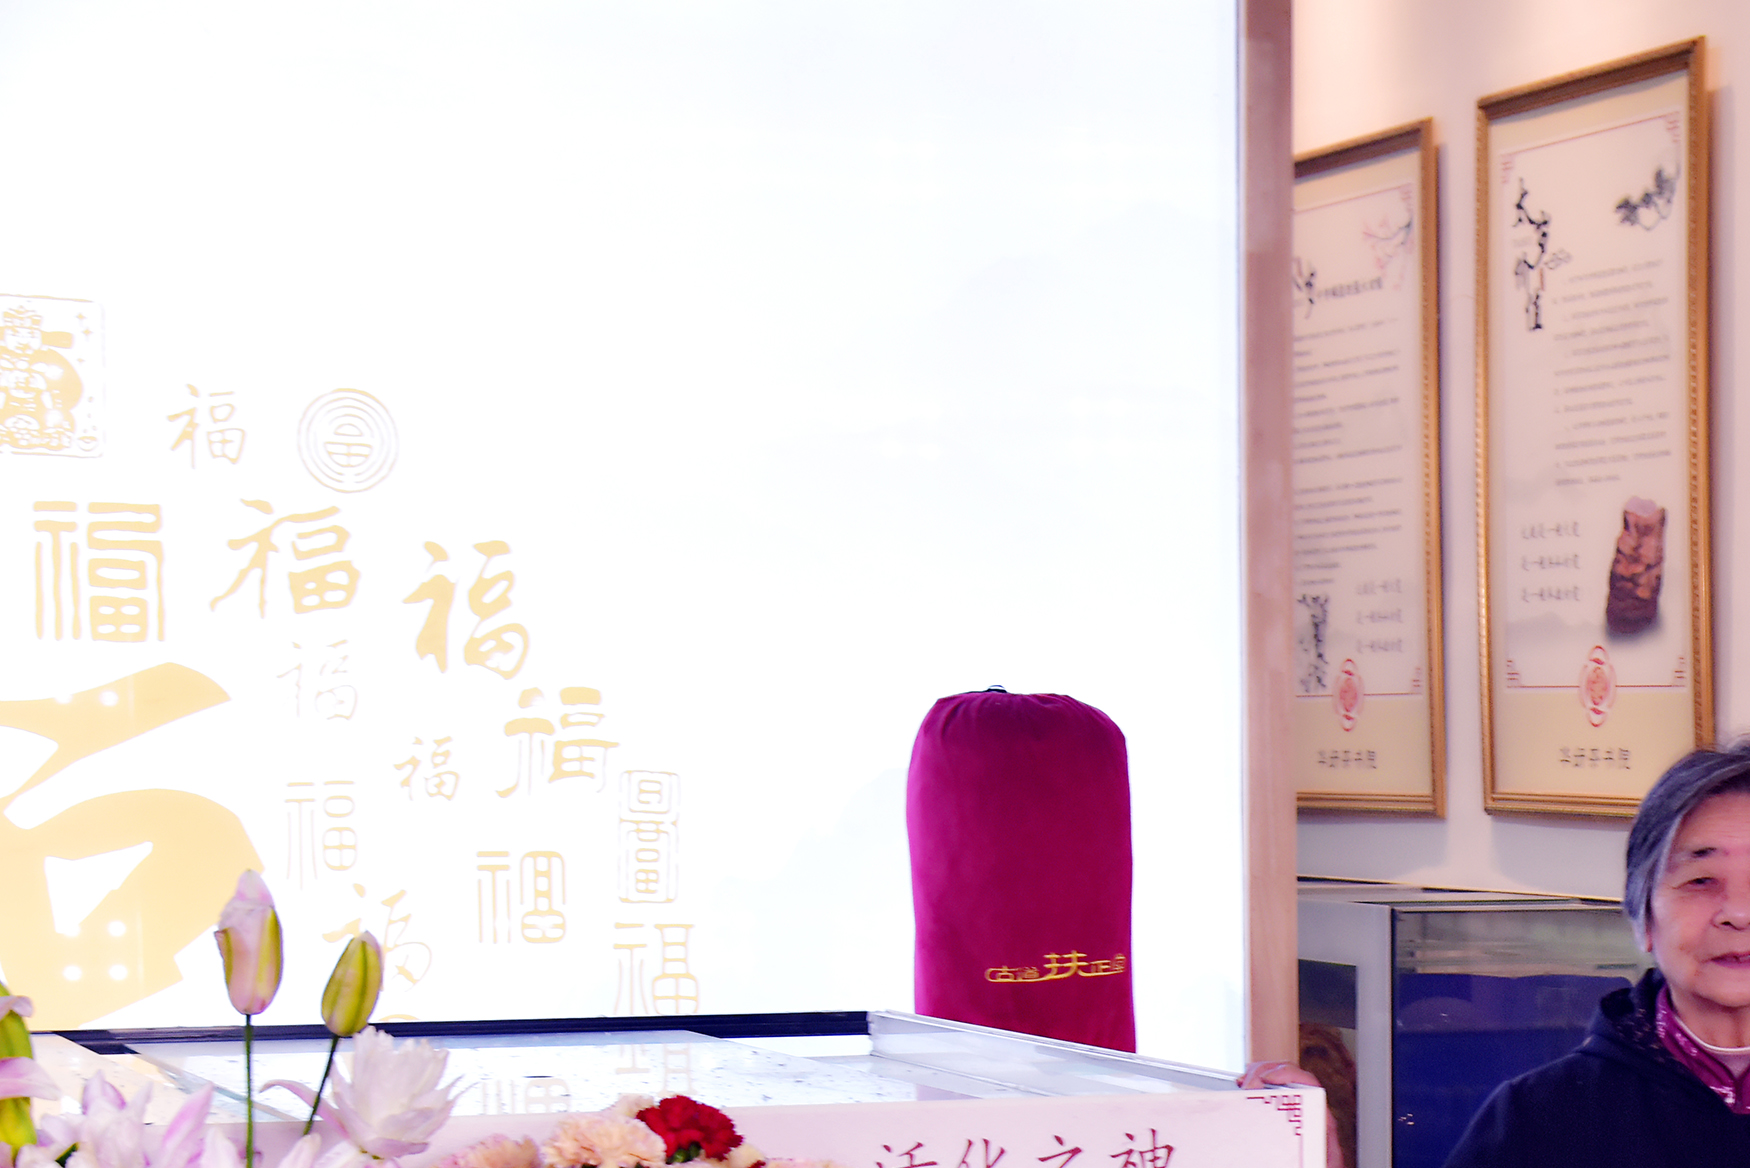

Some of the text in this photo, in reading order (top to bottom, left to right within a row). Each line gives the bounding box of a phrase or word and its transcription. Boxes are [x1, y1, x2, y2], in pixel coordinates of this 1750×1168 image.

[166, 384, 248, 470] 福
[33, 500, 167, 642] 福
[209, 498, 361, 619] 福
[403, 540, 532, 682] 福
[393, 735, 461, 802] 福
[497, 686, 620, 799] 福
[285, 780, 359, 890] 福
[477, 850, 567, 945] 福
